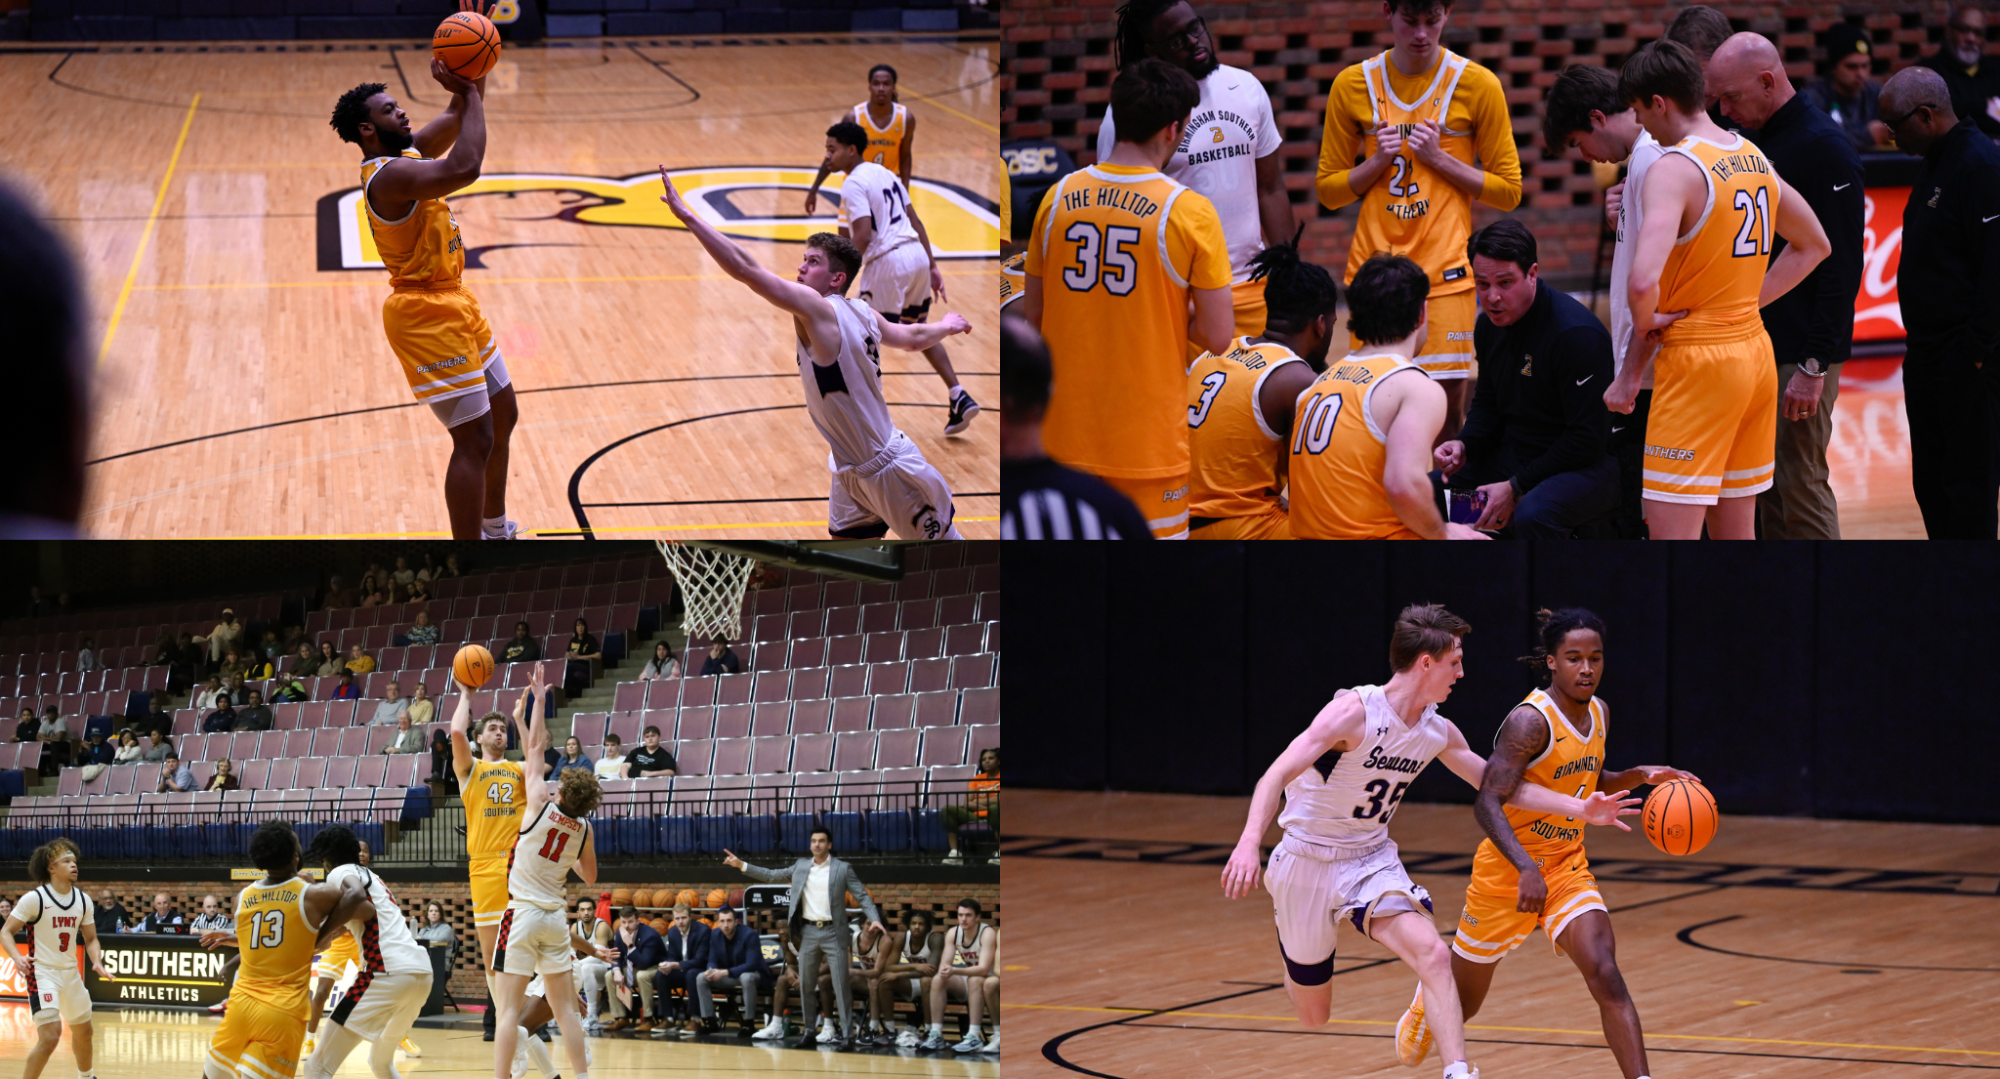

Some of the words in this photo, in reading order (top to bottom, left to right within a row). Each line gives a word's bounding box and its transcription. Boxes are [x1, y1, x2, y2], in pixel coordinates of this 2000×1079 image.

[1177, 110, 1217, 153] BIRMINGHAM
[1218, 110, 1256, 142] SOUTHERN
[1002, 147, 1059, 176] BSC
[1188, 143, 1251, 166] BASKETBALL
[1711, 158, 1733, 182] THE
[882, 181, 905, 225] 21
[1063, 188, 1091, 212] THE
[1096, 187, 1159, 219] HILLTOP
[1732, 186, 1770, 258] 21
[1062, 221, 1142, 297] 35
[416, 355, 467, 374] PANTHERS
[1188, 370, 1228, 429] 3
[1292, 393, 1343, 455] 10
[1644, 444, 1696, 461] ANTHERS
[487, 782, 514, 804] 42
[548, 810, 583, 833] DEMPSEY
[538, 827, 570, 864] 11
[244, 894, 259, 909] THE
[261, 889, 298, 904] HILLTOP
[52, 916, 77, 928] LYNX
[250, 908, 285, 950] 13
[59, 932, 71, 953] 3
[120, 985, 199, 1002] ATHLETICS
